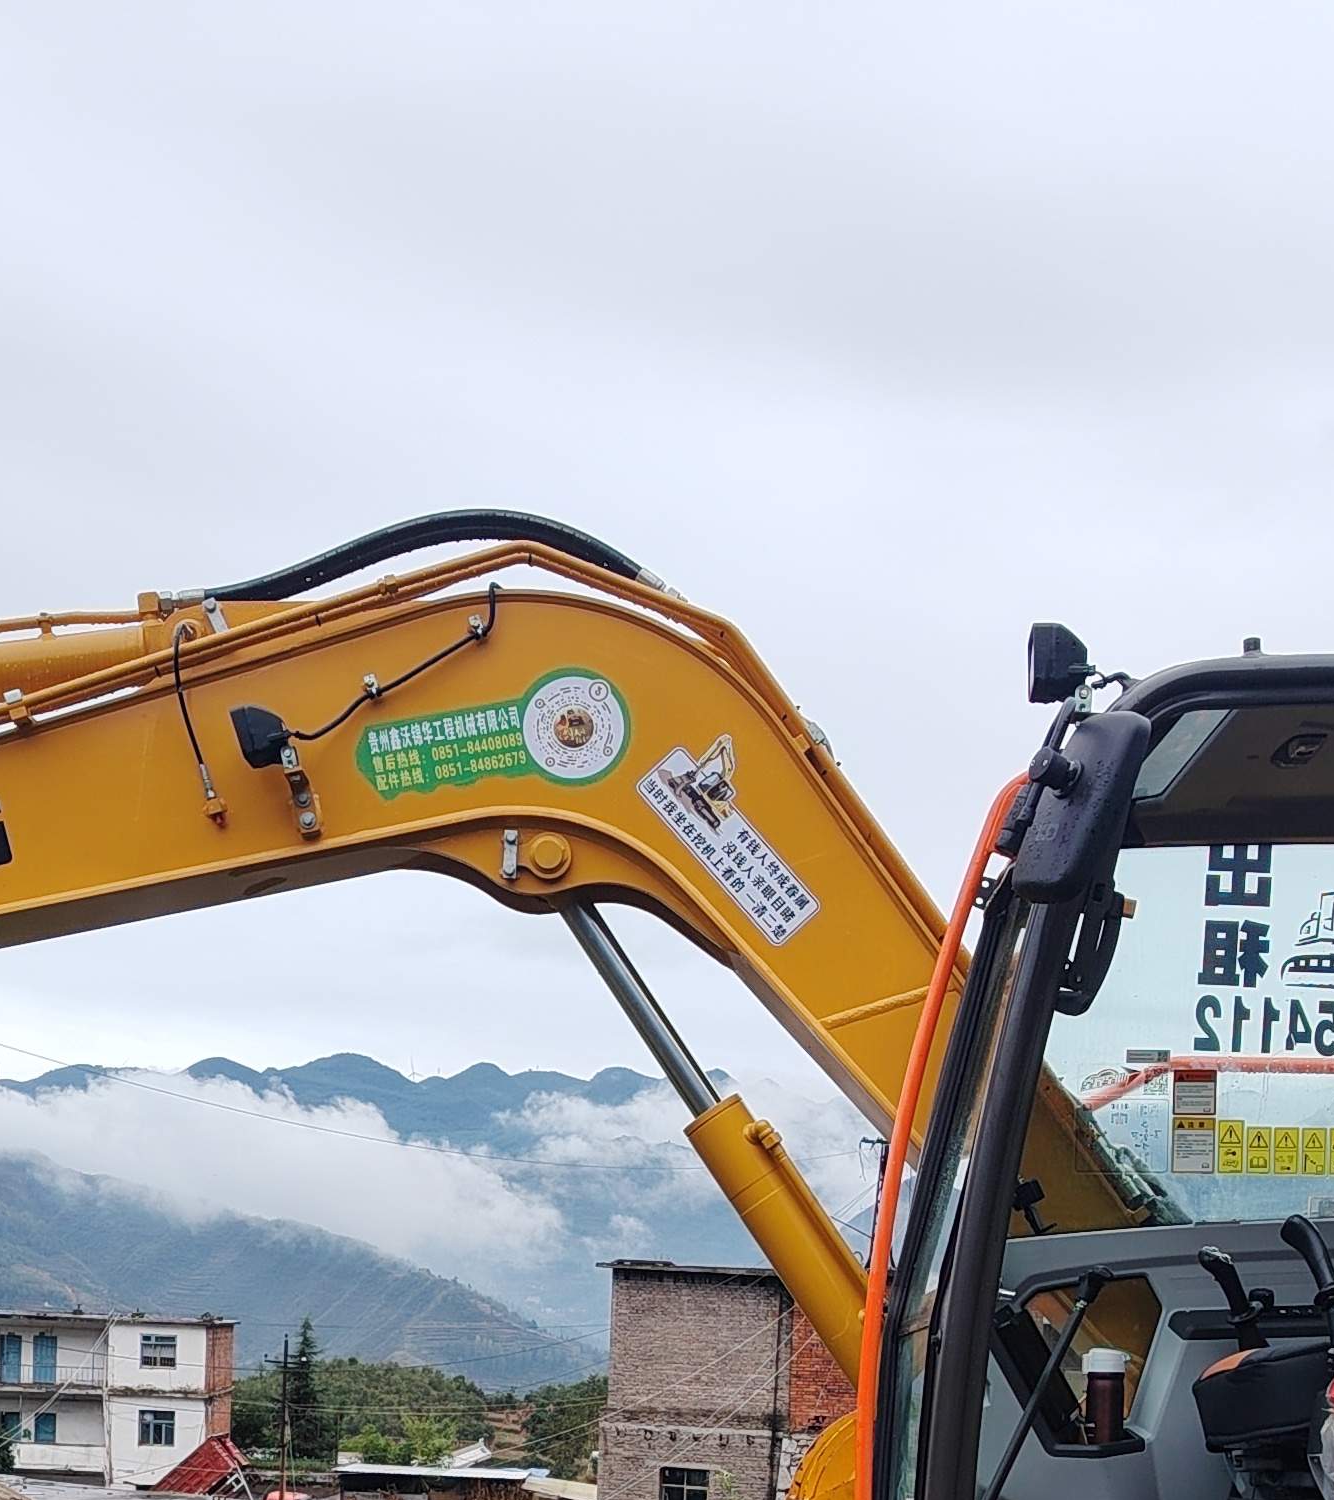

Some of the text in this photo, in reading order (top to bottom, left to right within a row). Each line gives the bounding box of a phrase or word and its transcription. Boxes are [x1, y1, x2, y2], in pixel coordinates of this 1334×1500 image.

[721, 840, 796, 923] 没钱人亲眼目睹
[737, 827, 810, 910] 有钱人终成眷属
